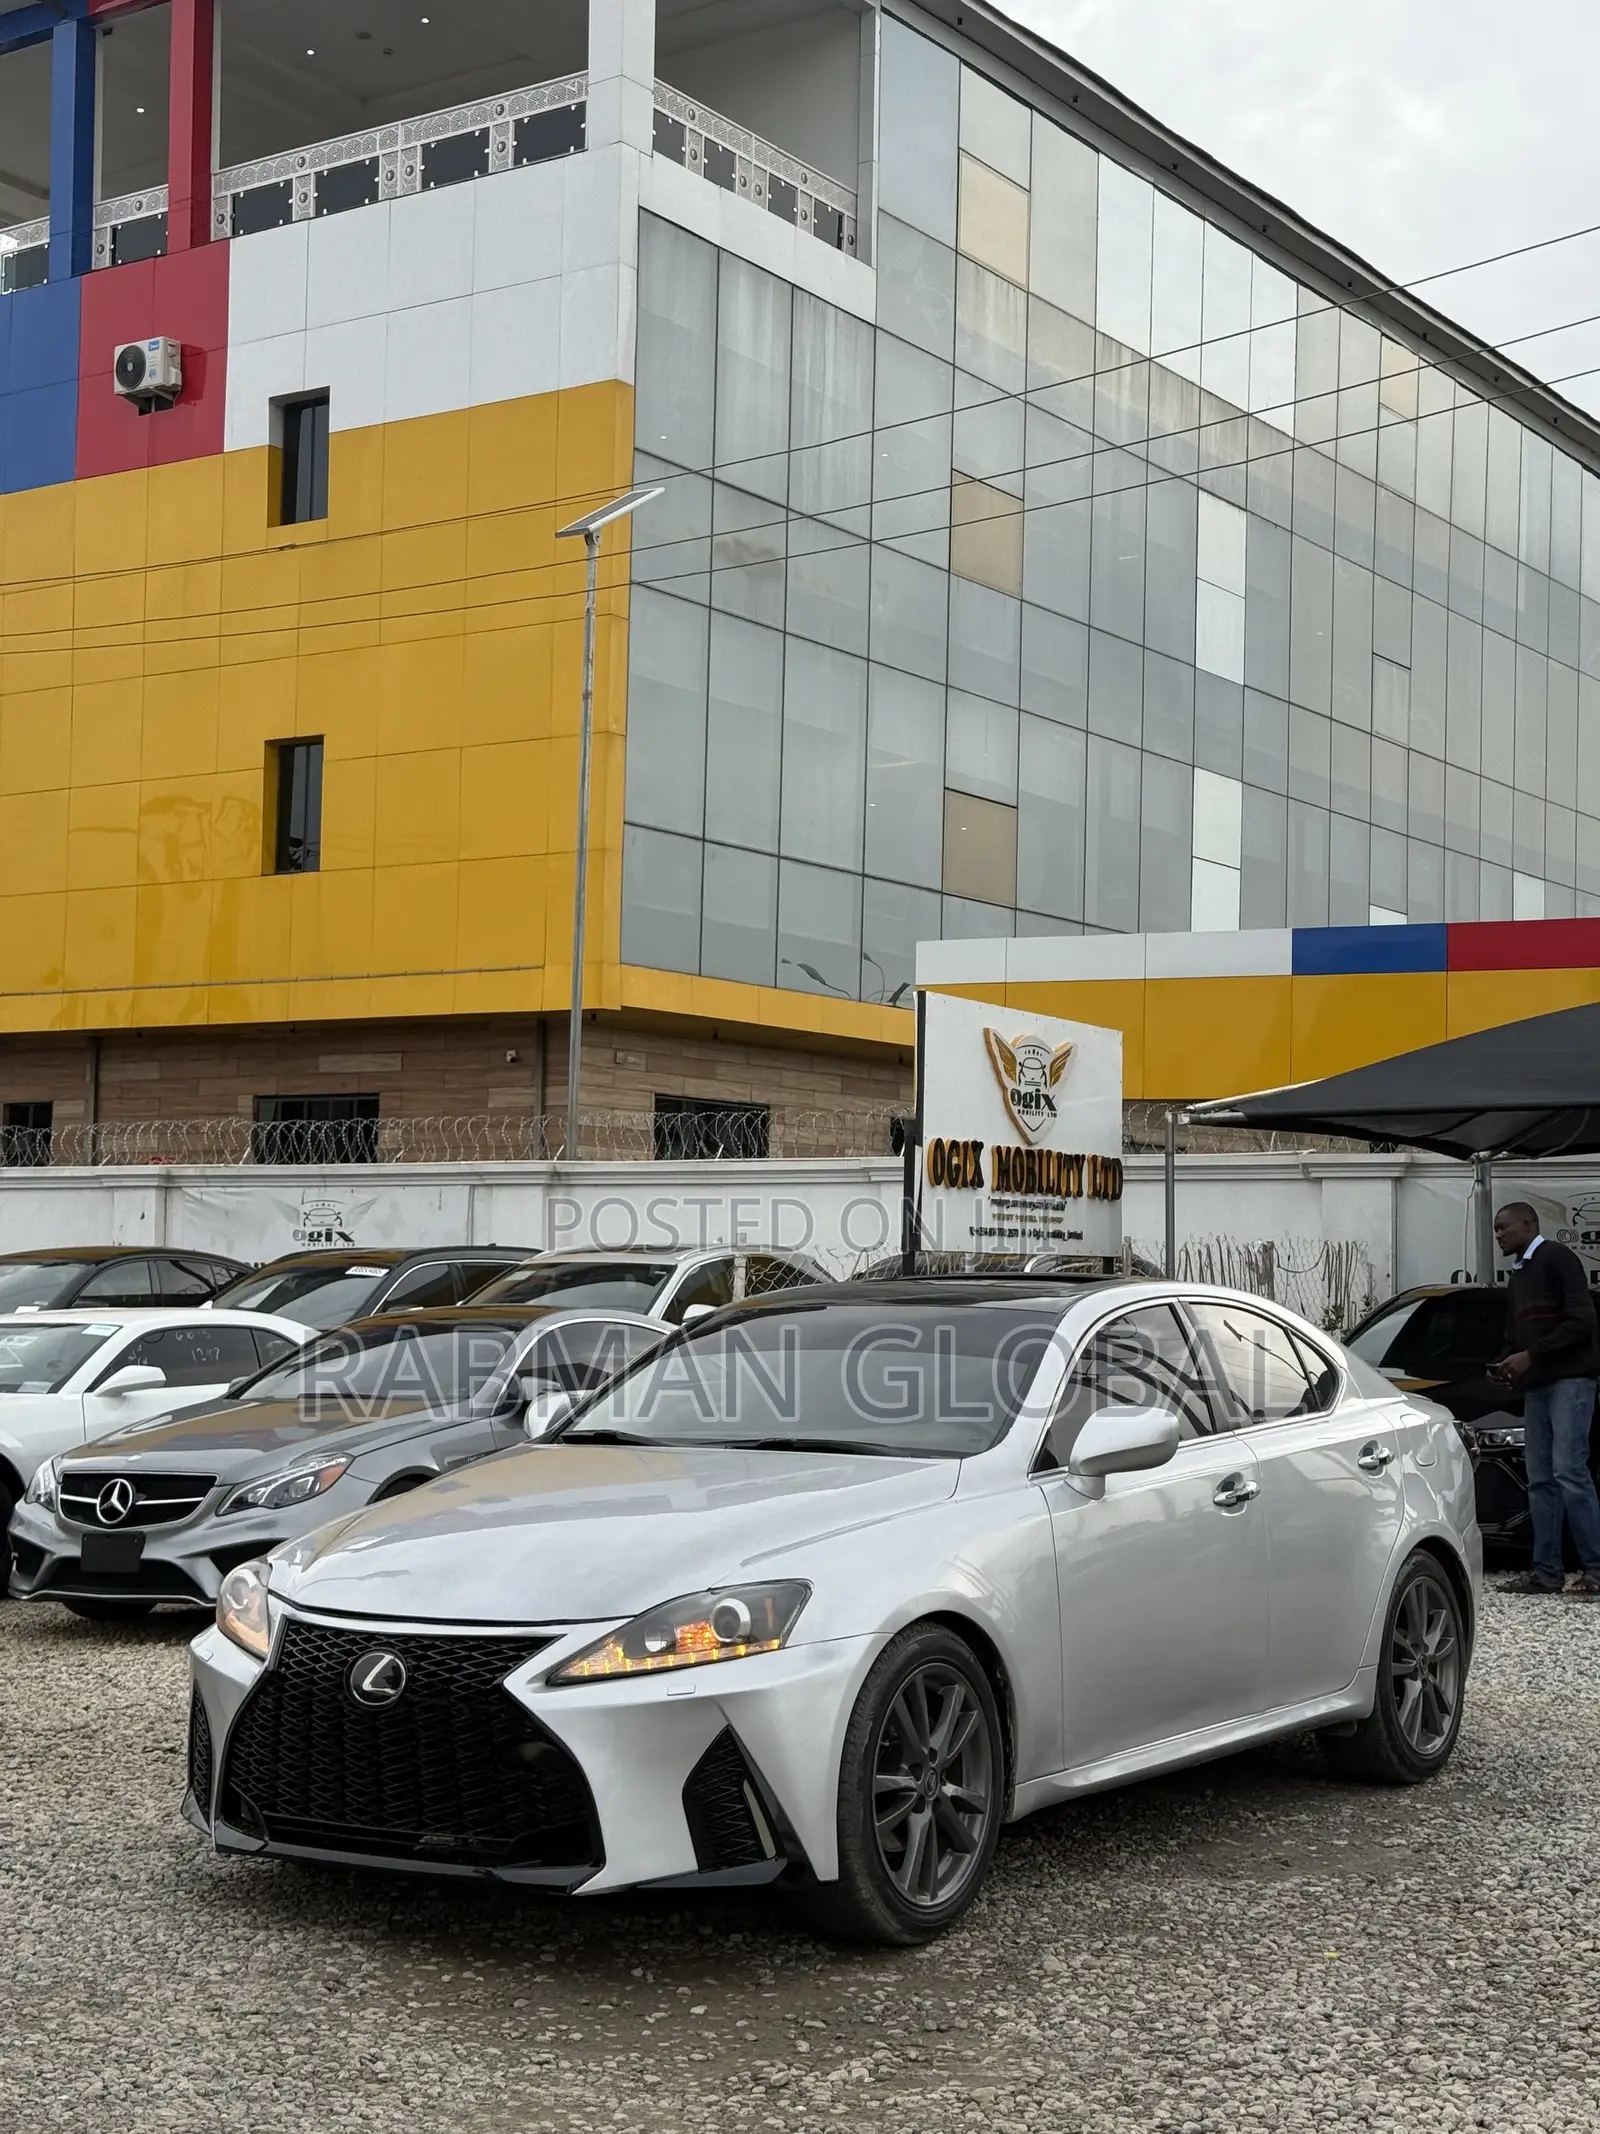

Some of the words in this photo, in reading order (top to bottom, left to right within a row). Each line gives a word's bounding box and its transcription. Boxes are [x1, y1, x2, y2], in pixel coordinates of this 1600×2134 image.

[928, 1137, 984, 1188] OGIX
[991, 1145, 1086, 1198] MOBILITY
[1087, 1154, 1123, 1200] LTD
